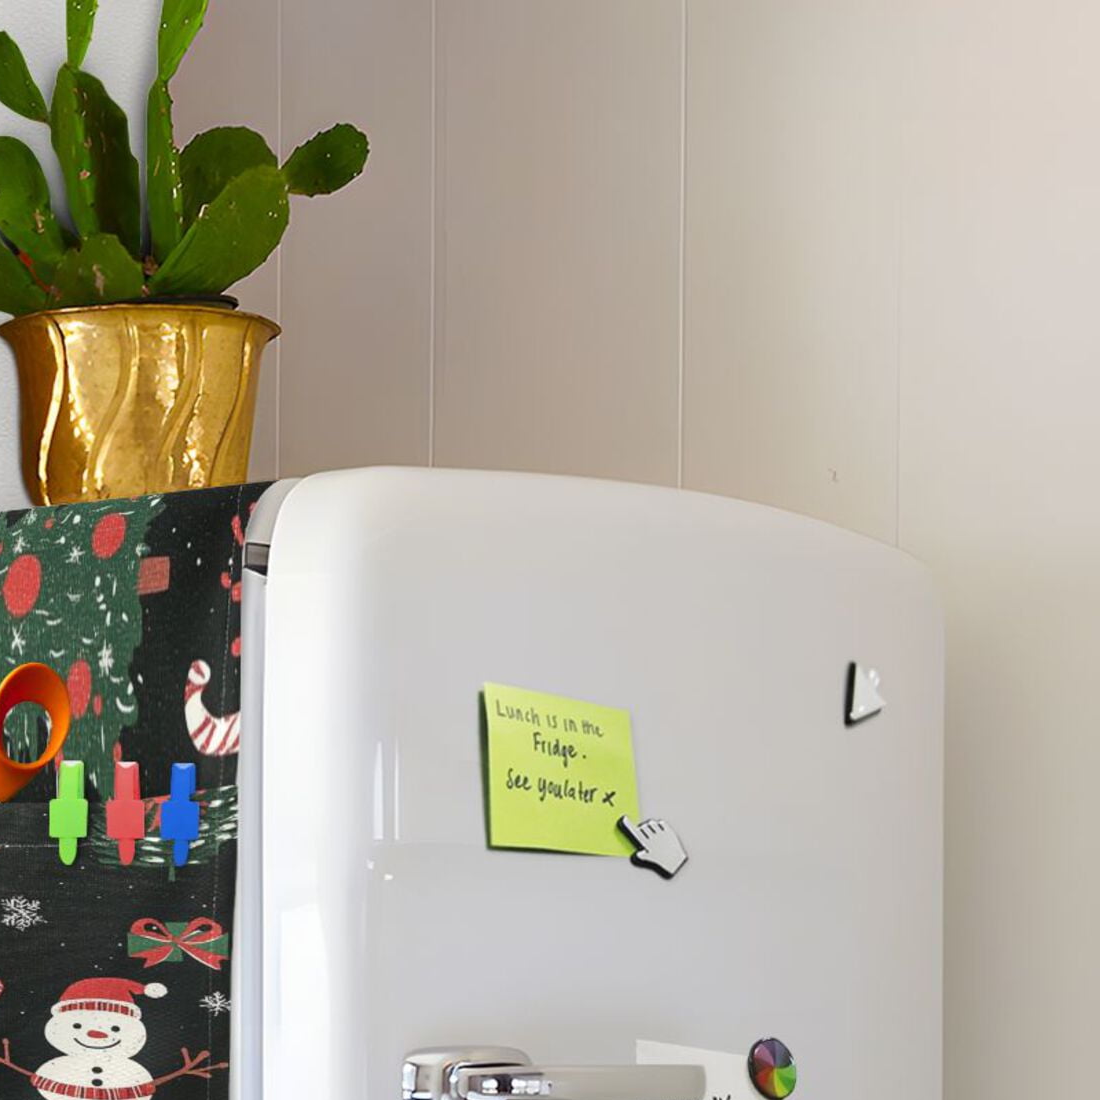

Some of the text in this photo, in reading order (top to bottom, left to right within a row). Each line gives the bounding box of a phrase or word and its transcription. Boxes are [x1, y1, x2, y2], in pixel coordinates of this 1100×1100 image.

[495, 698, 541, 727] Lunch
[581, 719, 604, 738] the
[506, 767, 532, 791] See
